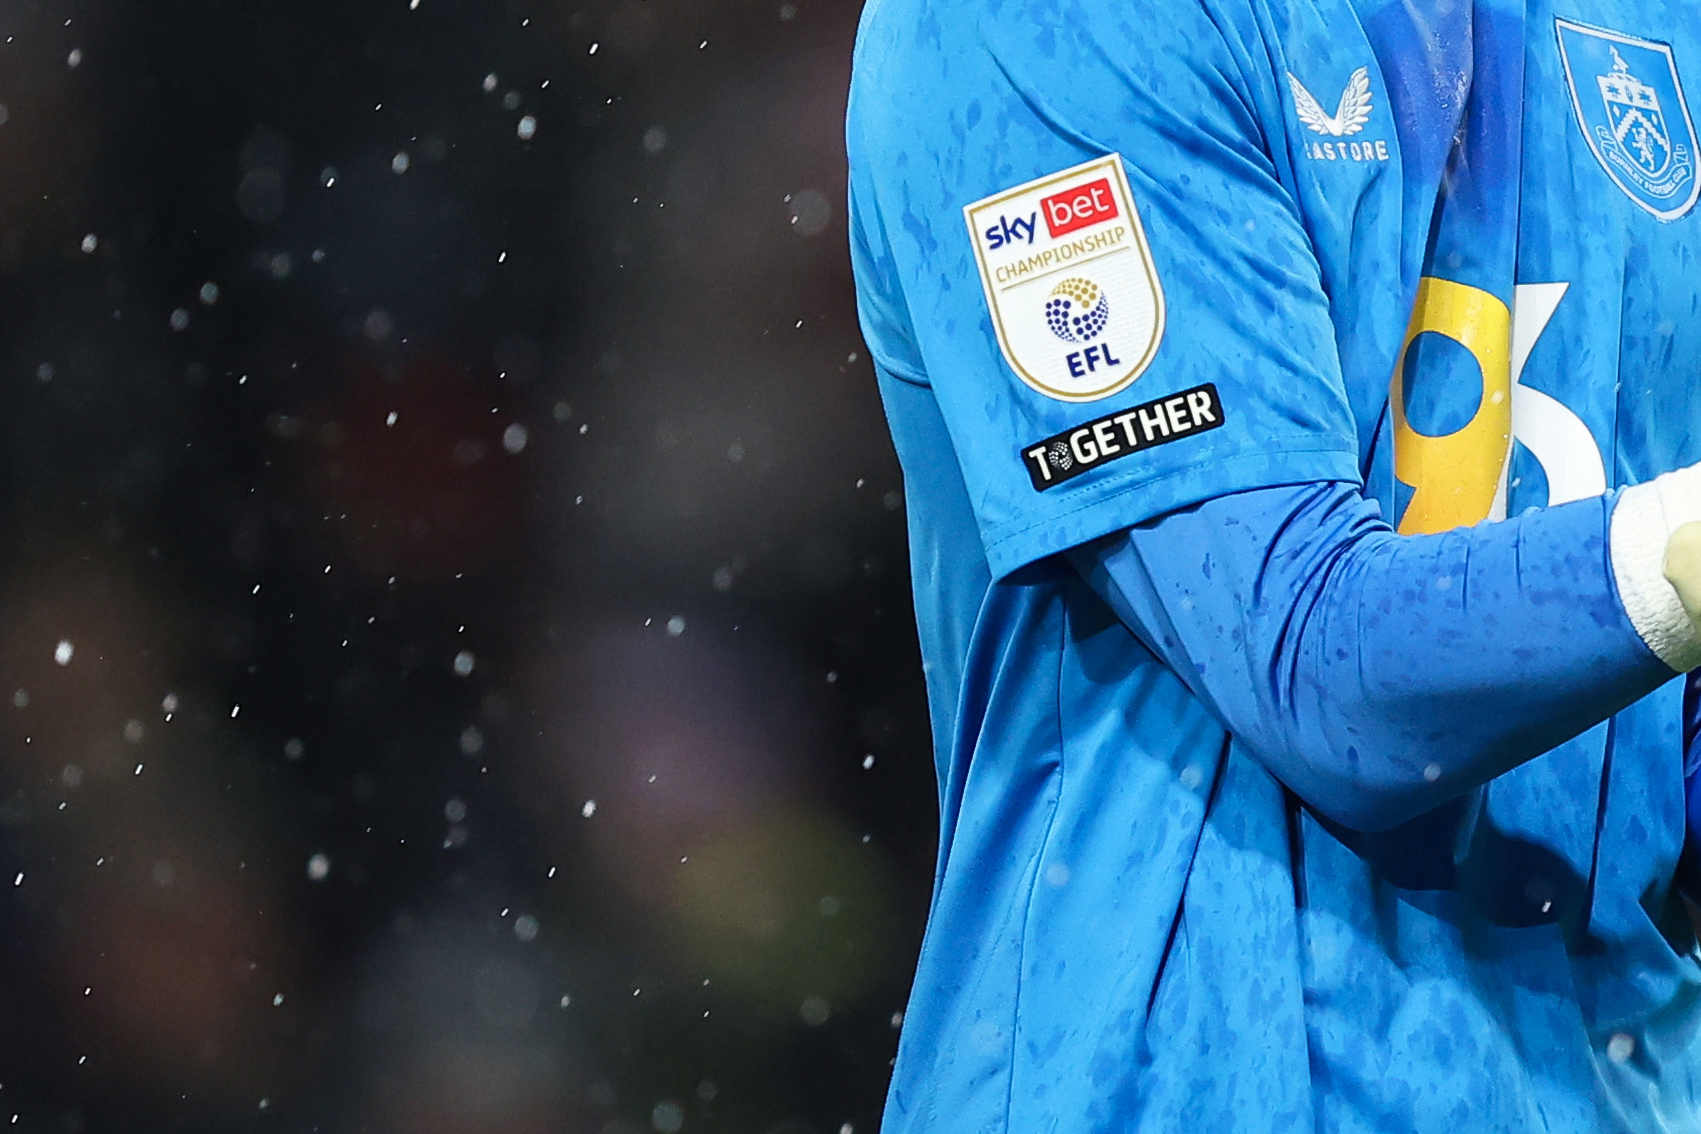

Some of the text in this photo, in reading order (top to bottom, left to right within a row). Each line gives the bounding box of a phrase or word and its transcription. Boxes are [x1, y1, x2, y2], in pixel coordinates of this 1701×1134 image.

[985, 187, 1110, 250] sky bet
[996, 226, 1125, 283] CHAMPIONSHIP
[1066, 343, 1120, 378] EFL
[1028, 390, 1216, 481] TOGETHER
